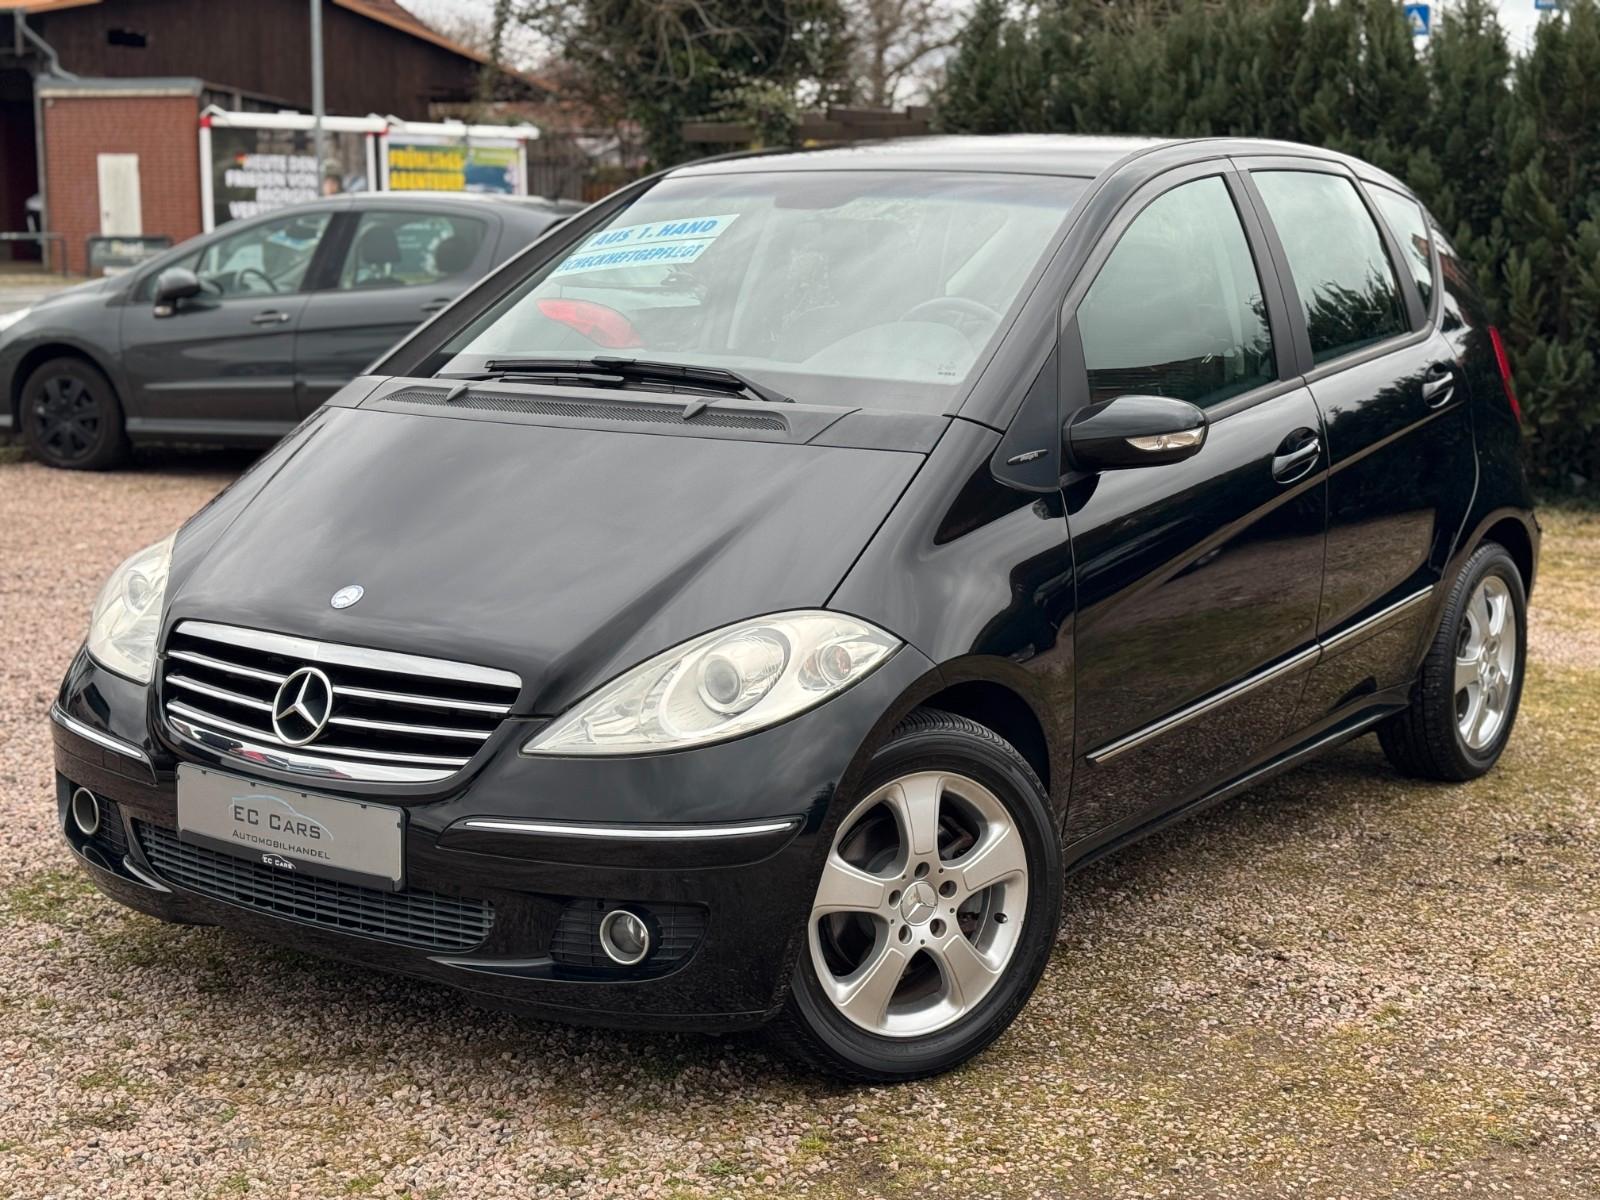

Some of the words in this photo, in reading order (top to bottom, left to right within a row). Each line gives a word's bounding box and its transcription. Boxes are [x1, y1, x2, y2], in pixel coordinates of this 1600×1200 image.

[591, 229, 634, 247] AUS
[656, 219, 718, 237] HAND
[557, 244, 705, 271] SCHECKHEFTGEPFLEGT
[234, 805, 259, 826] EC
[269, 813, 321, 840] CARS
[263, 856, 273, 865] EC
